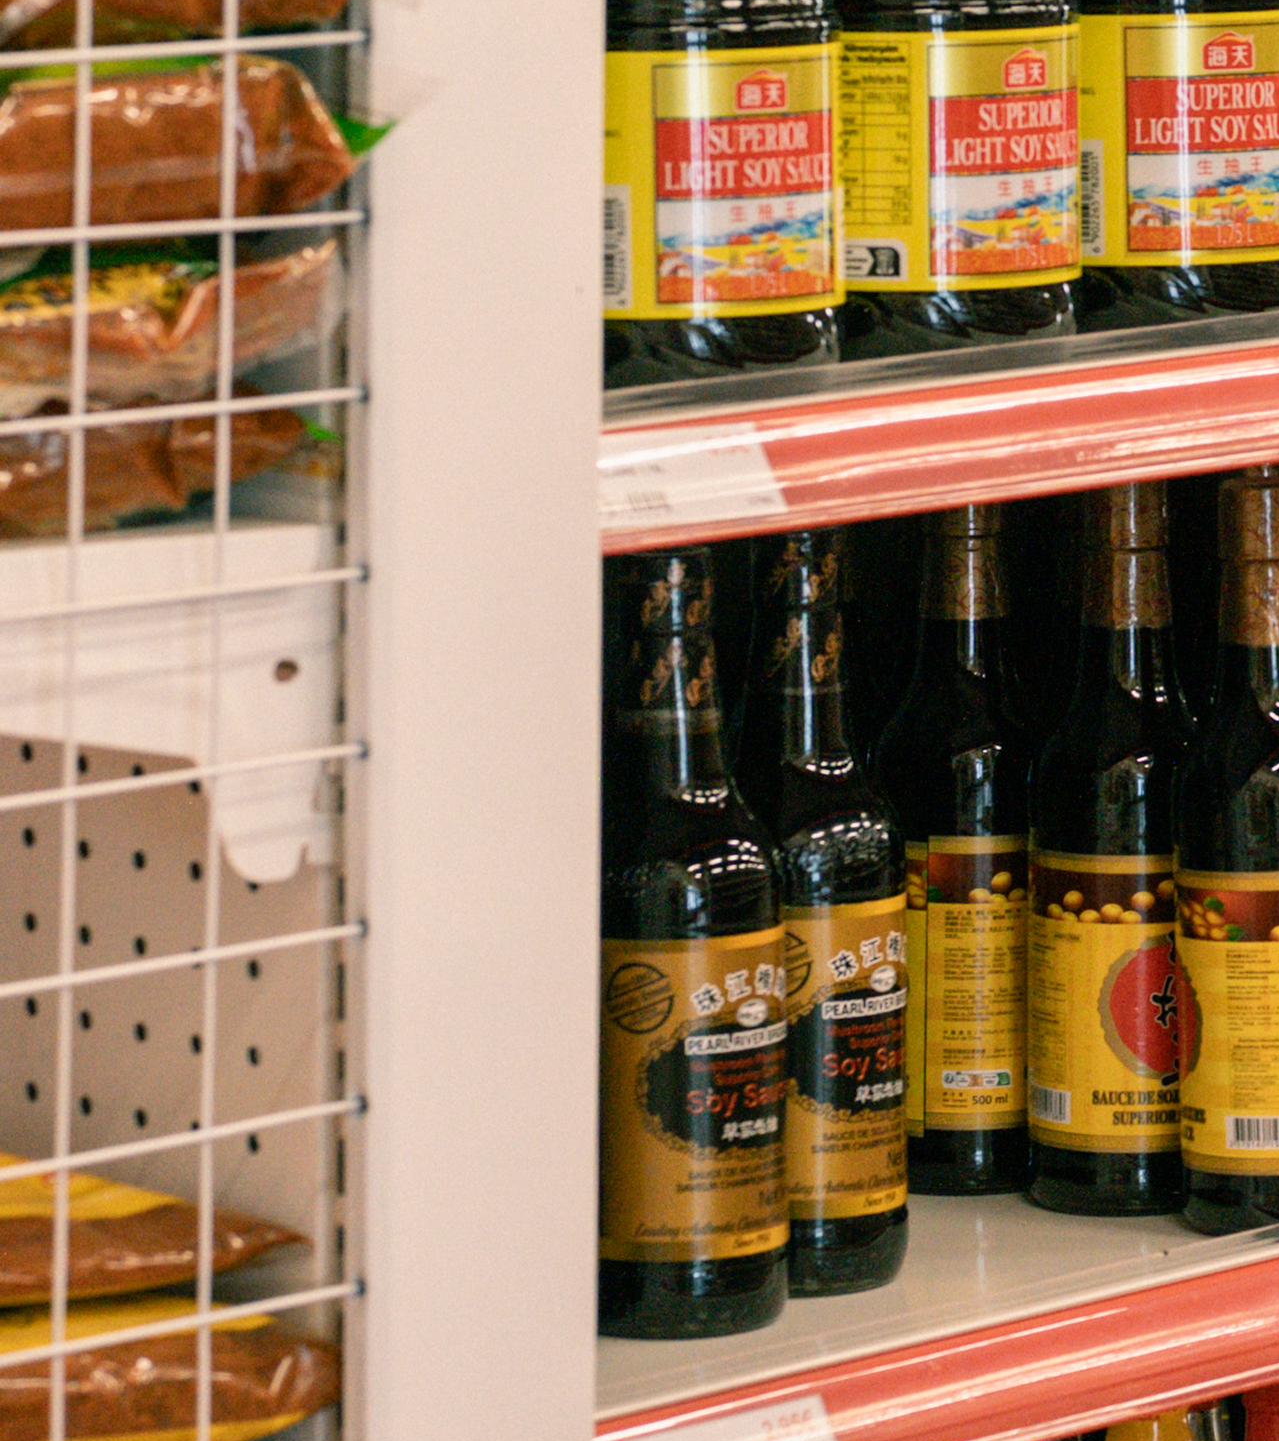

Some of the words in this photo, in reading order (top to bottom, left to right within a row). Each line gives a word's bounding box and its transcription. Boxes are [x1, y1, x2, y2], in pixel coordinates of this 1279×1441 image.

[1208, 45, 1249, 66] 海天
[1176, 81, 1275, 111] SUPERIOR
[978, 99, 1062, 131] SUPERIOR
[1134, 117, 1204, 144] LIGHT
[1210, 115, 1253, 142] SOY
[708, 121, 808, 154] SUPERIOR
[1010, 133, 1044, 163] SOY
[664, 160, 739, 190] LIGHT
[742, 157, 787, 187] SOY
[824, 1001, 862, 1018] PEARL
[687, 1034, 728, 1054] PEARL
[823, 1051, 869, 1080] Soy
[687, 1090, 737, 1117] Soy
[971, 1093, 993, 1106] 500
[1092, 1089, 1134, 1106] SAUCE
